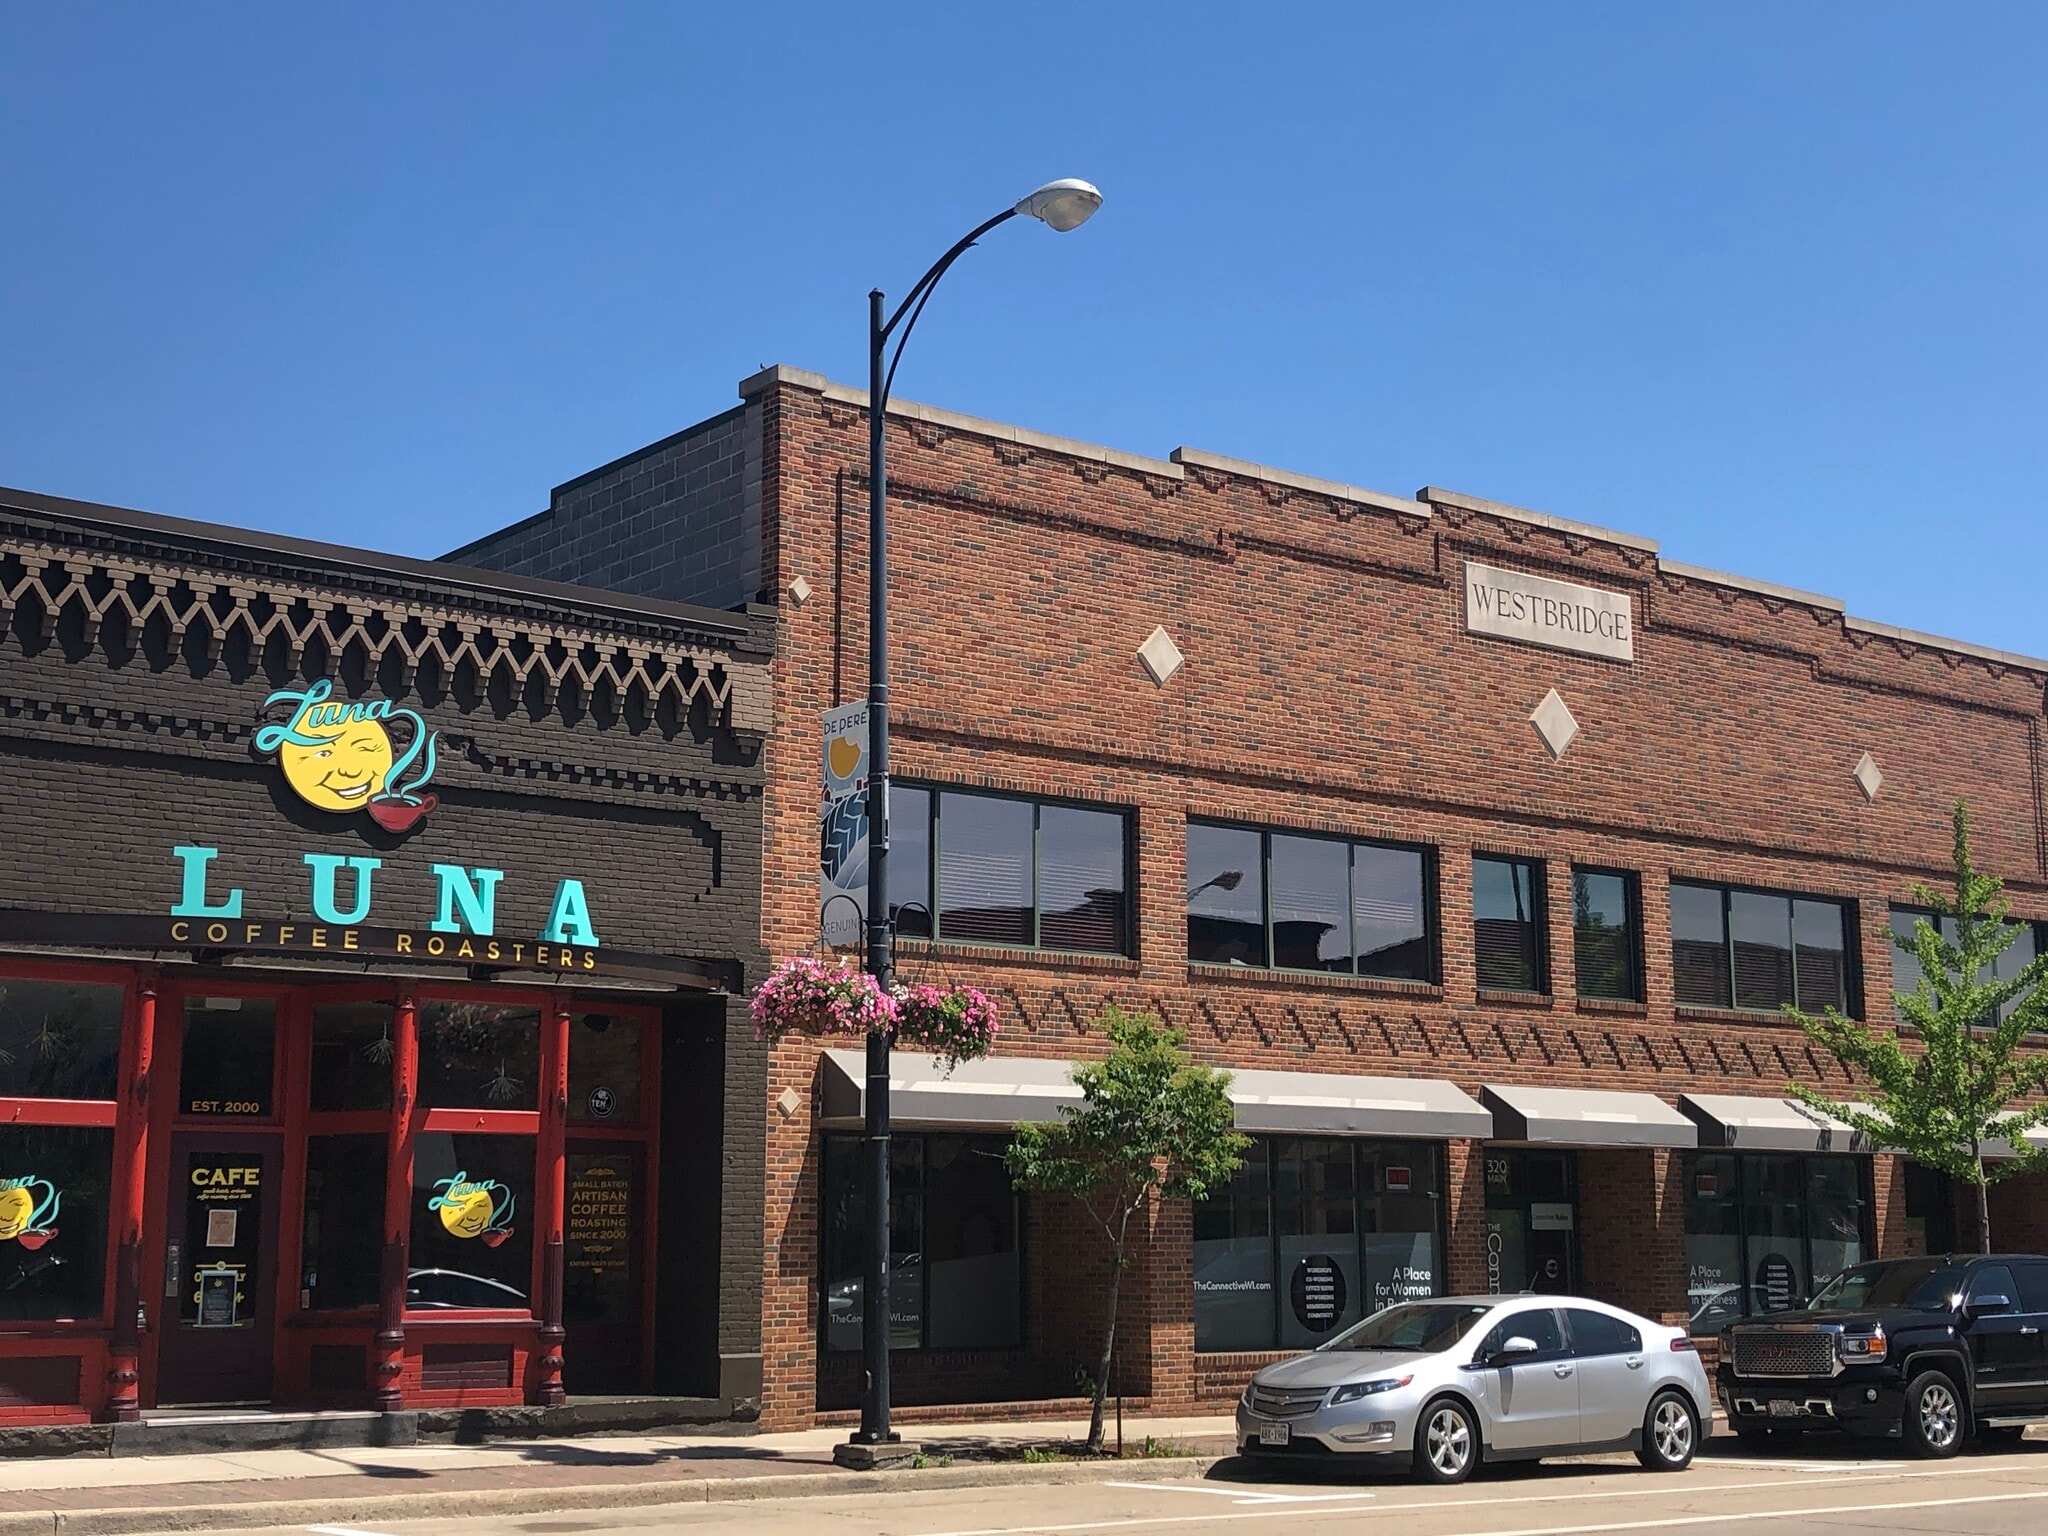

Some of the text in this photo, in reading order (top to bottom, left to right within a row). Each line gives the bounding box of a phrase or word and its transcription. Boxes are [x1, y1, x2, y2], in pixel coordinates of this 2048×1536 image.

[1472, 583, 1628, 641] WESTBRIDGE
[256, 679, 393, 751] Luna
[824, 711, 867, 735] DE PERE
[171, 846, 600, 947] LUNA
[824, 918, 861, 935] GENUIN
[171, 921, 596, 970] COFFEE ROASTERS
[191, 1101, 260, 1113] EST. 2000
[1487, 1160, 1507, 1174] 320
[191, 1167, 260, 1186] CAFE
[428, 1170, 496, 1211] Luna
[572, 1191, 628, 1201] ARTISAN
[571, 1204, 627, 1215] COFFEE
[570, 1218, 627, 1228] ROASTING
[1487, 1223, 1501, 1232] THE
[570, 1230, 627, 1240] SINCE 2000
[1392, 1266, 1432, 1281] A Place
[1690, 1265, 1722, 1278] A Place
[1375, 1282, 1432, 1296] for Women
[1691, 1295, 1700, 1305] in
